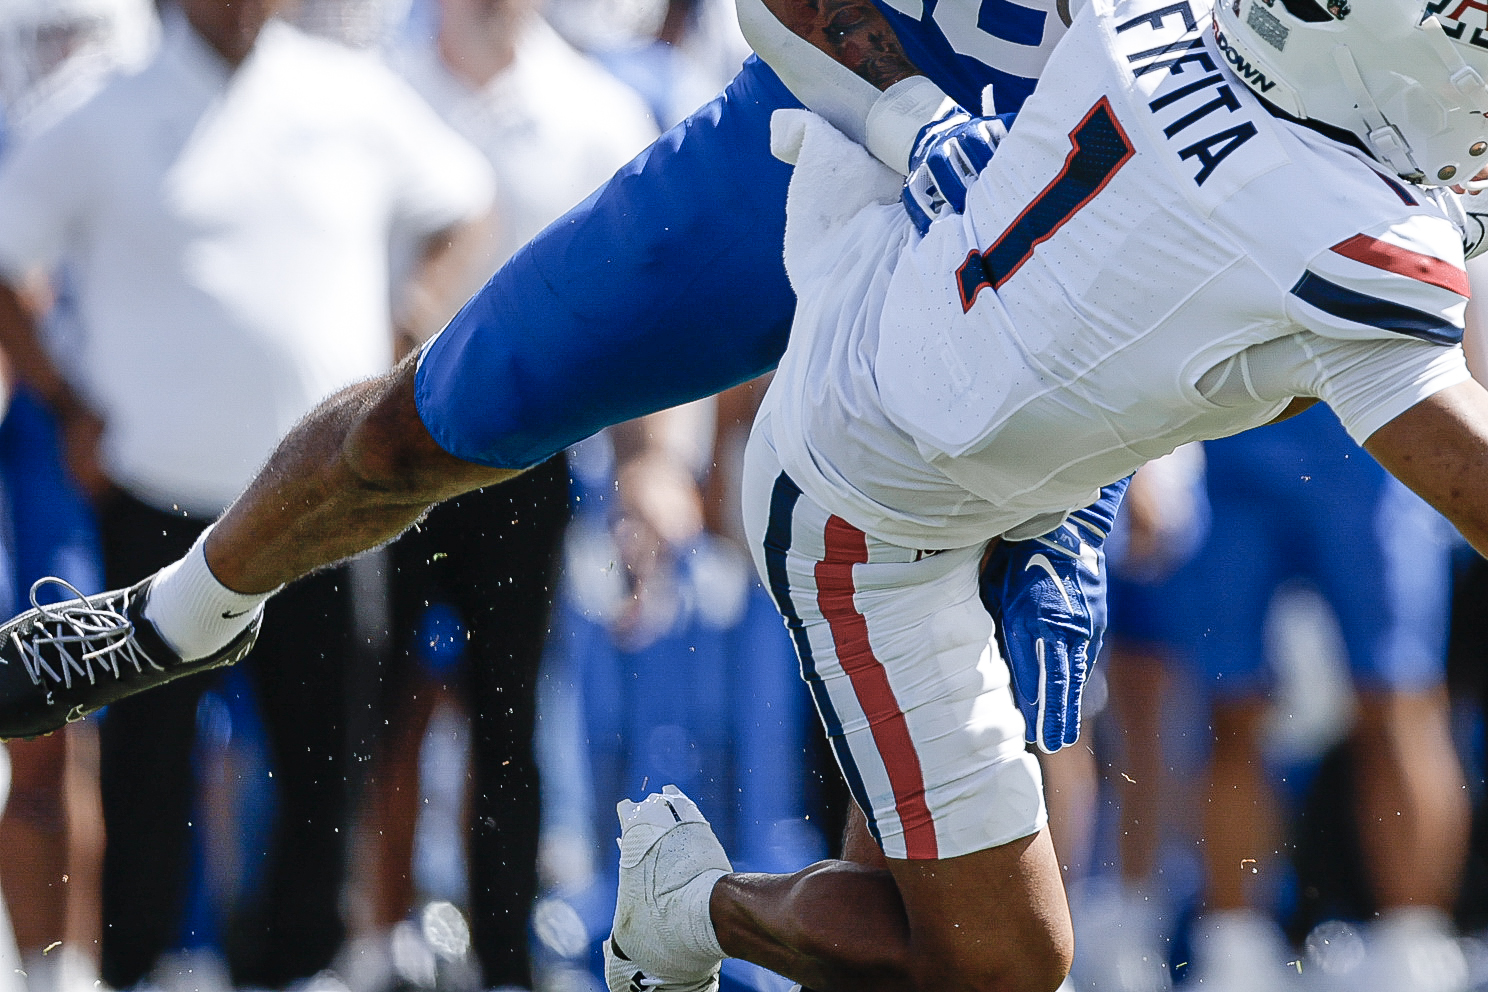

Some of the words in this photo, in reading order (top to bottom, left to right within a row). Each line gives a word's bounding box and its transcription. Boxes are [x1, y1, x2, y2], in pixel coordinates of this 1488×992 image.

[1115, 0, 1259, 187] FIFITA
[1217, 31, 1277, 93] DOWN
[955, 95, 1136, 315] 1
